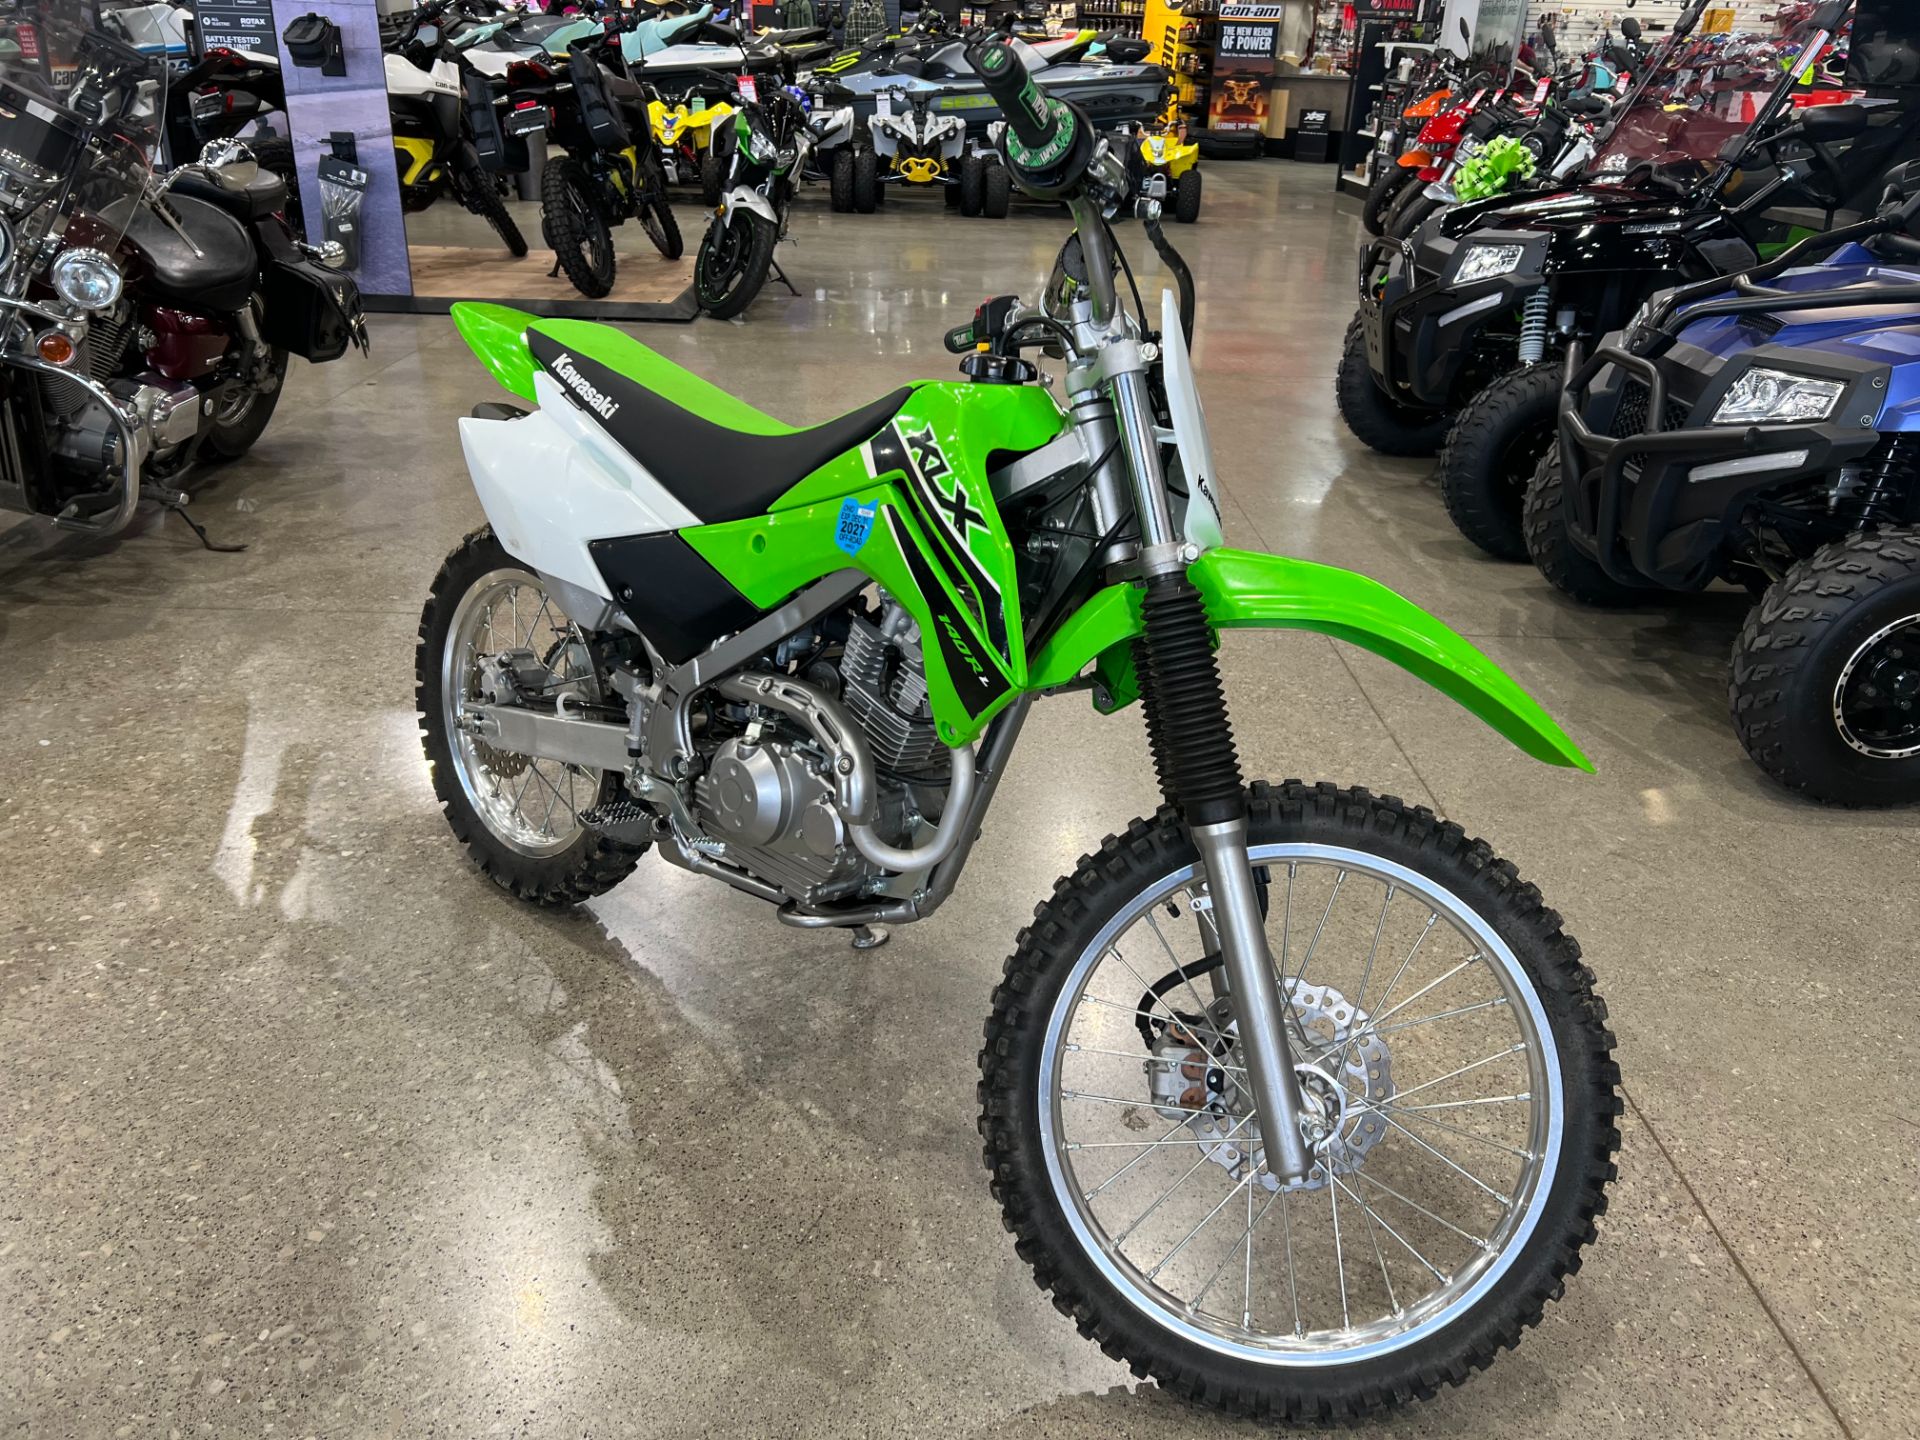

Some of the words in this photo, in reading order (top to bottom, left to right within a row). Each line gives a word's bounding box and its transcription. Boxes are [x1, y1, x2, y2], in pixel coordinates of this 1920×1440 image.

[1220, 6, 1280, 17] can-am
[240, 17, 266, 25] ROTAX
[1223, 26, 1235, 35] THE
[1236, 26, 1251, 35] NEW
[1252, 27, 1273, 36] REIGN
[205, 35, 261, 44] BATTLE-TESTED
[1222, 36, 1235, 49] OF
[1236, 37, 1271, 50] POWER
[551, 352, 620, 420] Kawasaki
[905, 421, 992, 547] KLX
[840, 520, 865, 537] 2027
